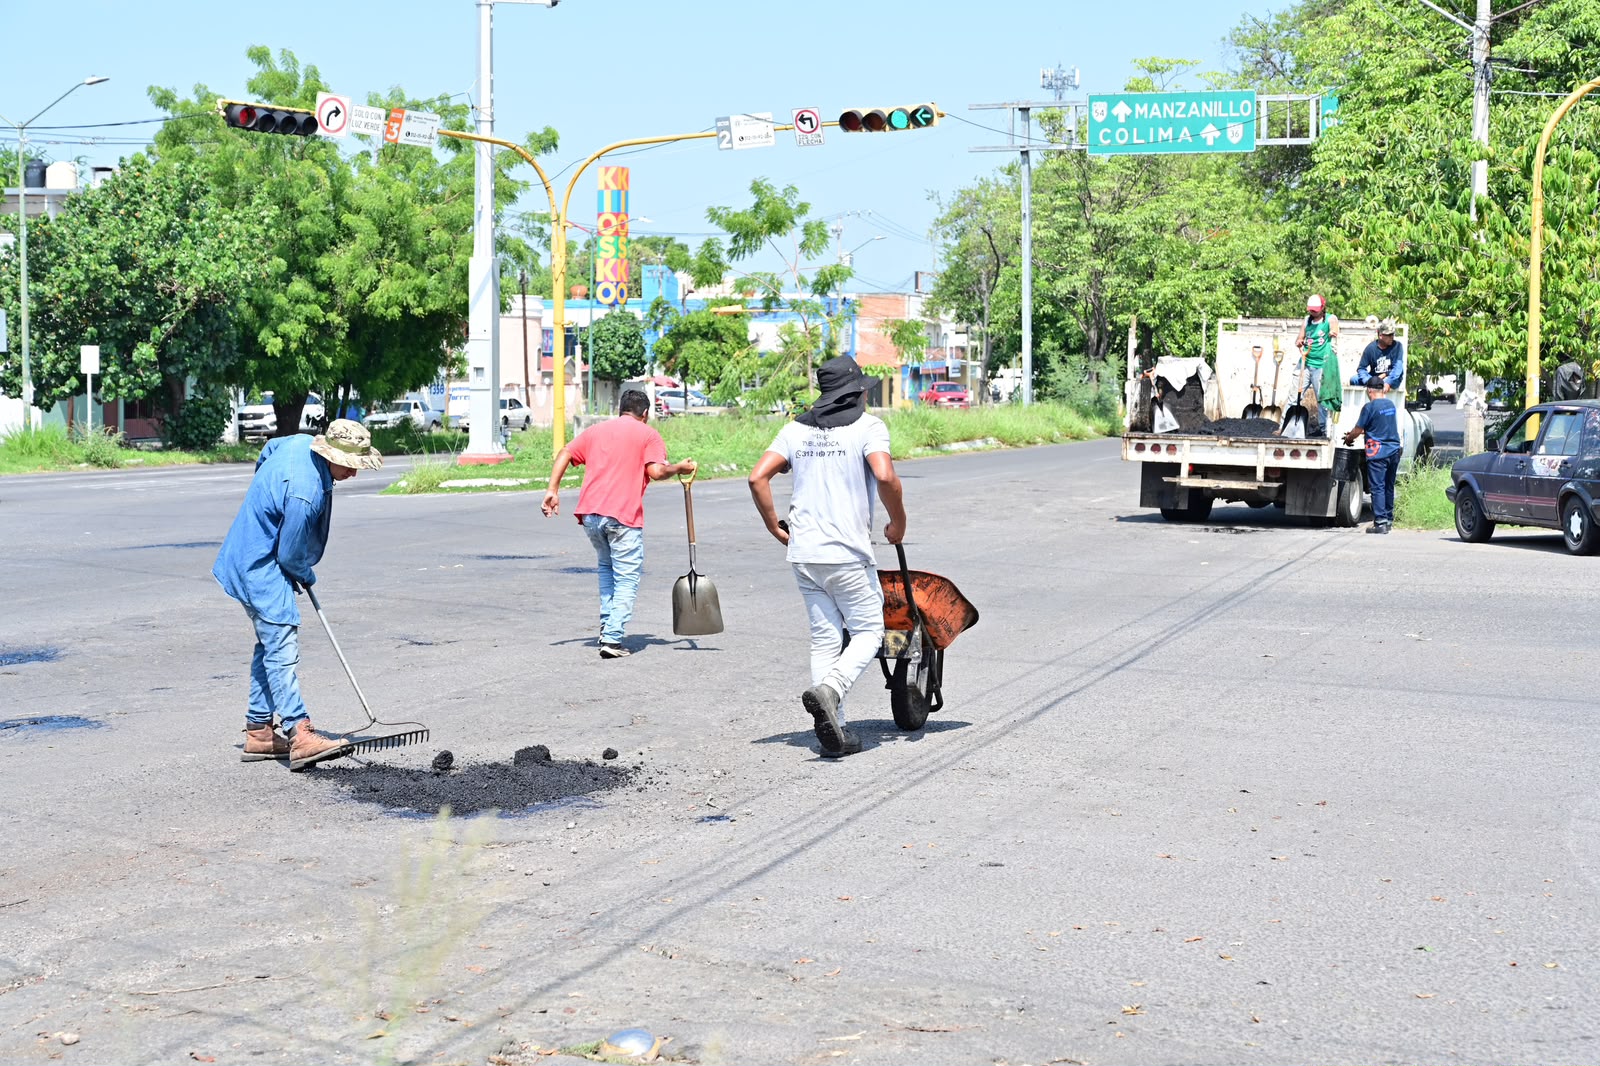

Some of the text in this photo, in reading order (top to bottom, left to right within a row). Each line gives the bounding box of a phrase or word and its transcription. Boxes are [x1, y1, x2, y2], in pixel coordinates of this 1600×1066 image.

[354, 109, 369, 120] SOLO
[370, 111, 382, 121] CON
[1094, 100, 1252, 119] 54 MANZANILLO
[351, 121, 380, 131] LUZ VERDE
[385, 122, 400, 140] 3
[719, 130, 733, 149] 2
[1099, 127, 1240, 145] COLIMA 36
[596, 166, 617, 305] KIOSKO
